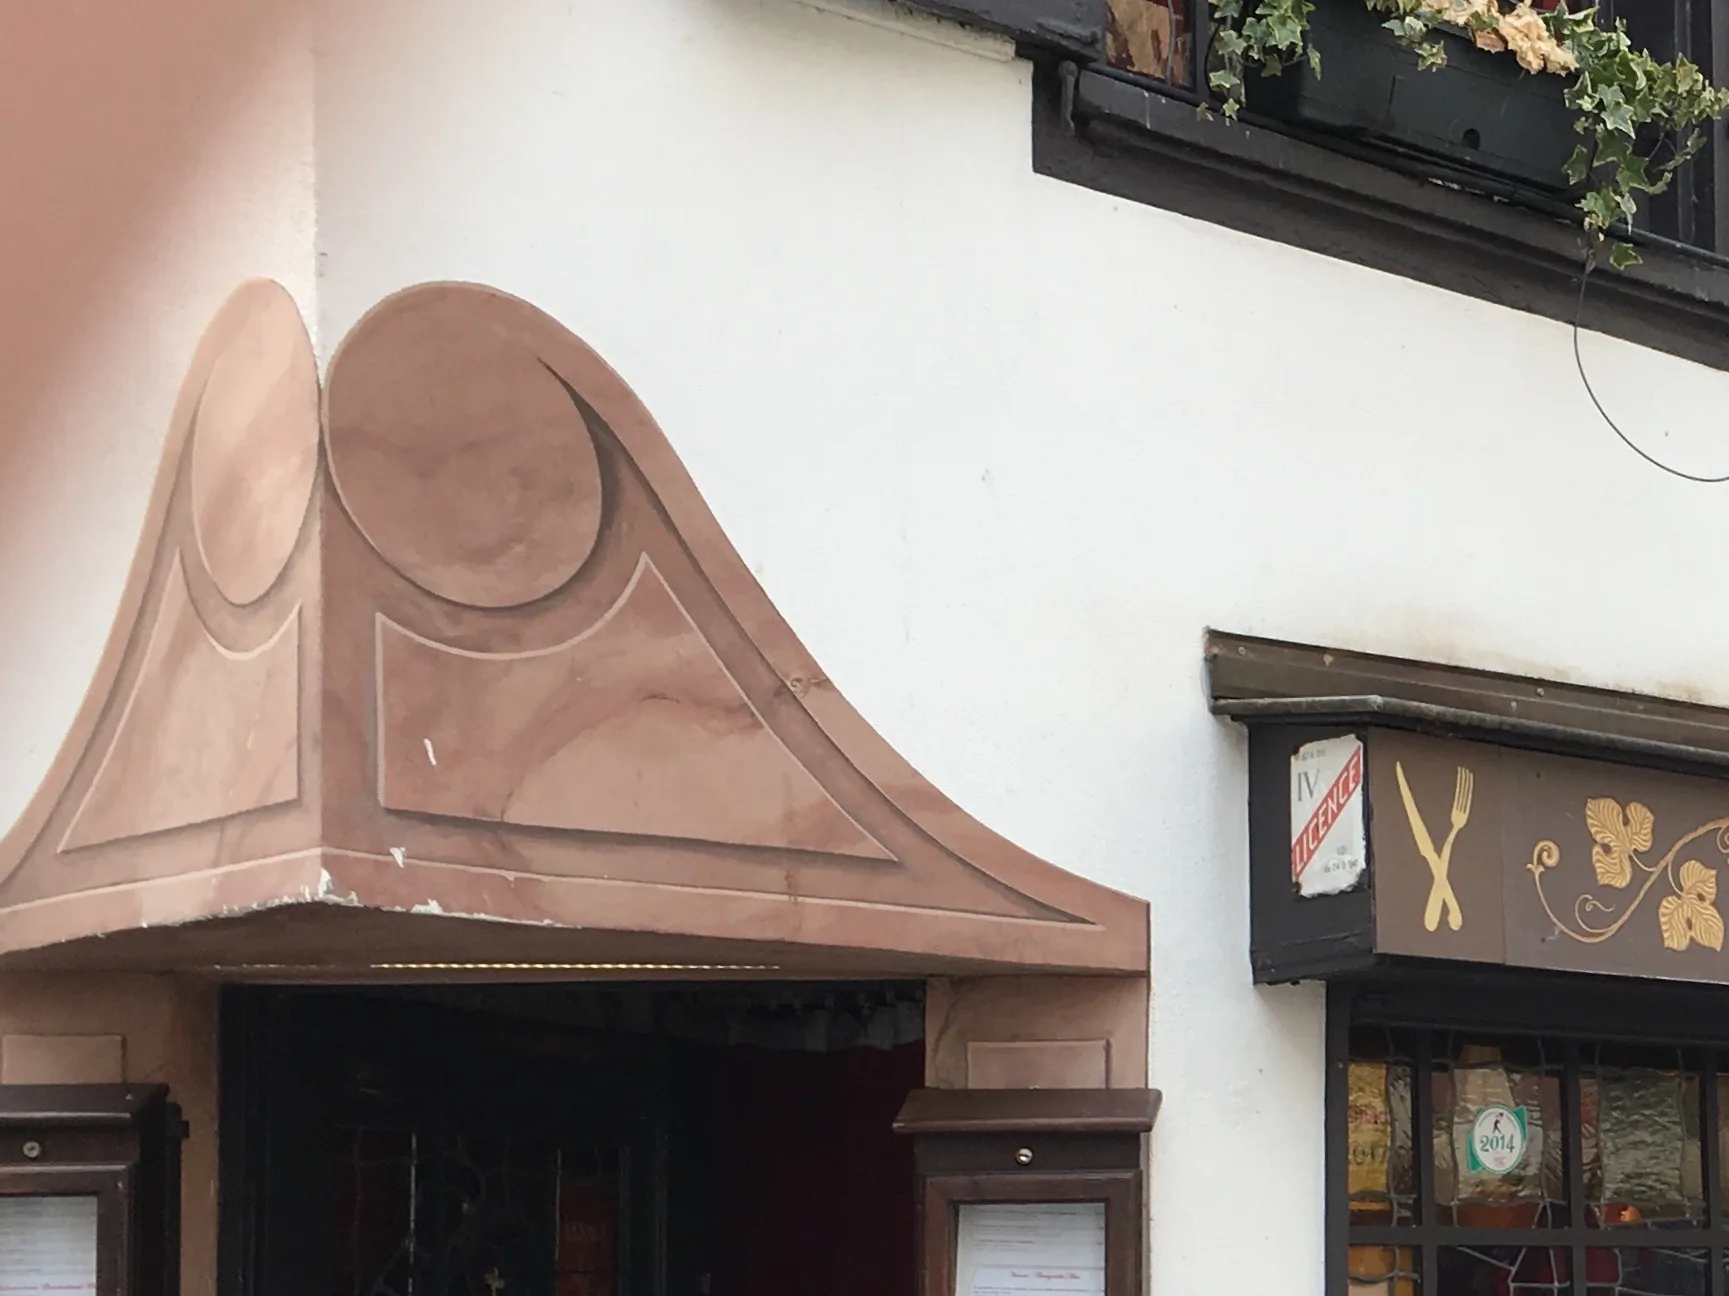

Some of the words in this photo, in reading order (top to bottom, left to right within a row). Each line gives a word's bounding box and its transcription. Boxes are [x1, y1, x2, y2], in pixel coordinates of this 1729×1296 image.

[1297, 768, 1321, 802] IV
[1294, 753, 1359, 873] LICENCE
[1479, 1134, 1516, 1153] 2014
